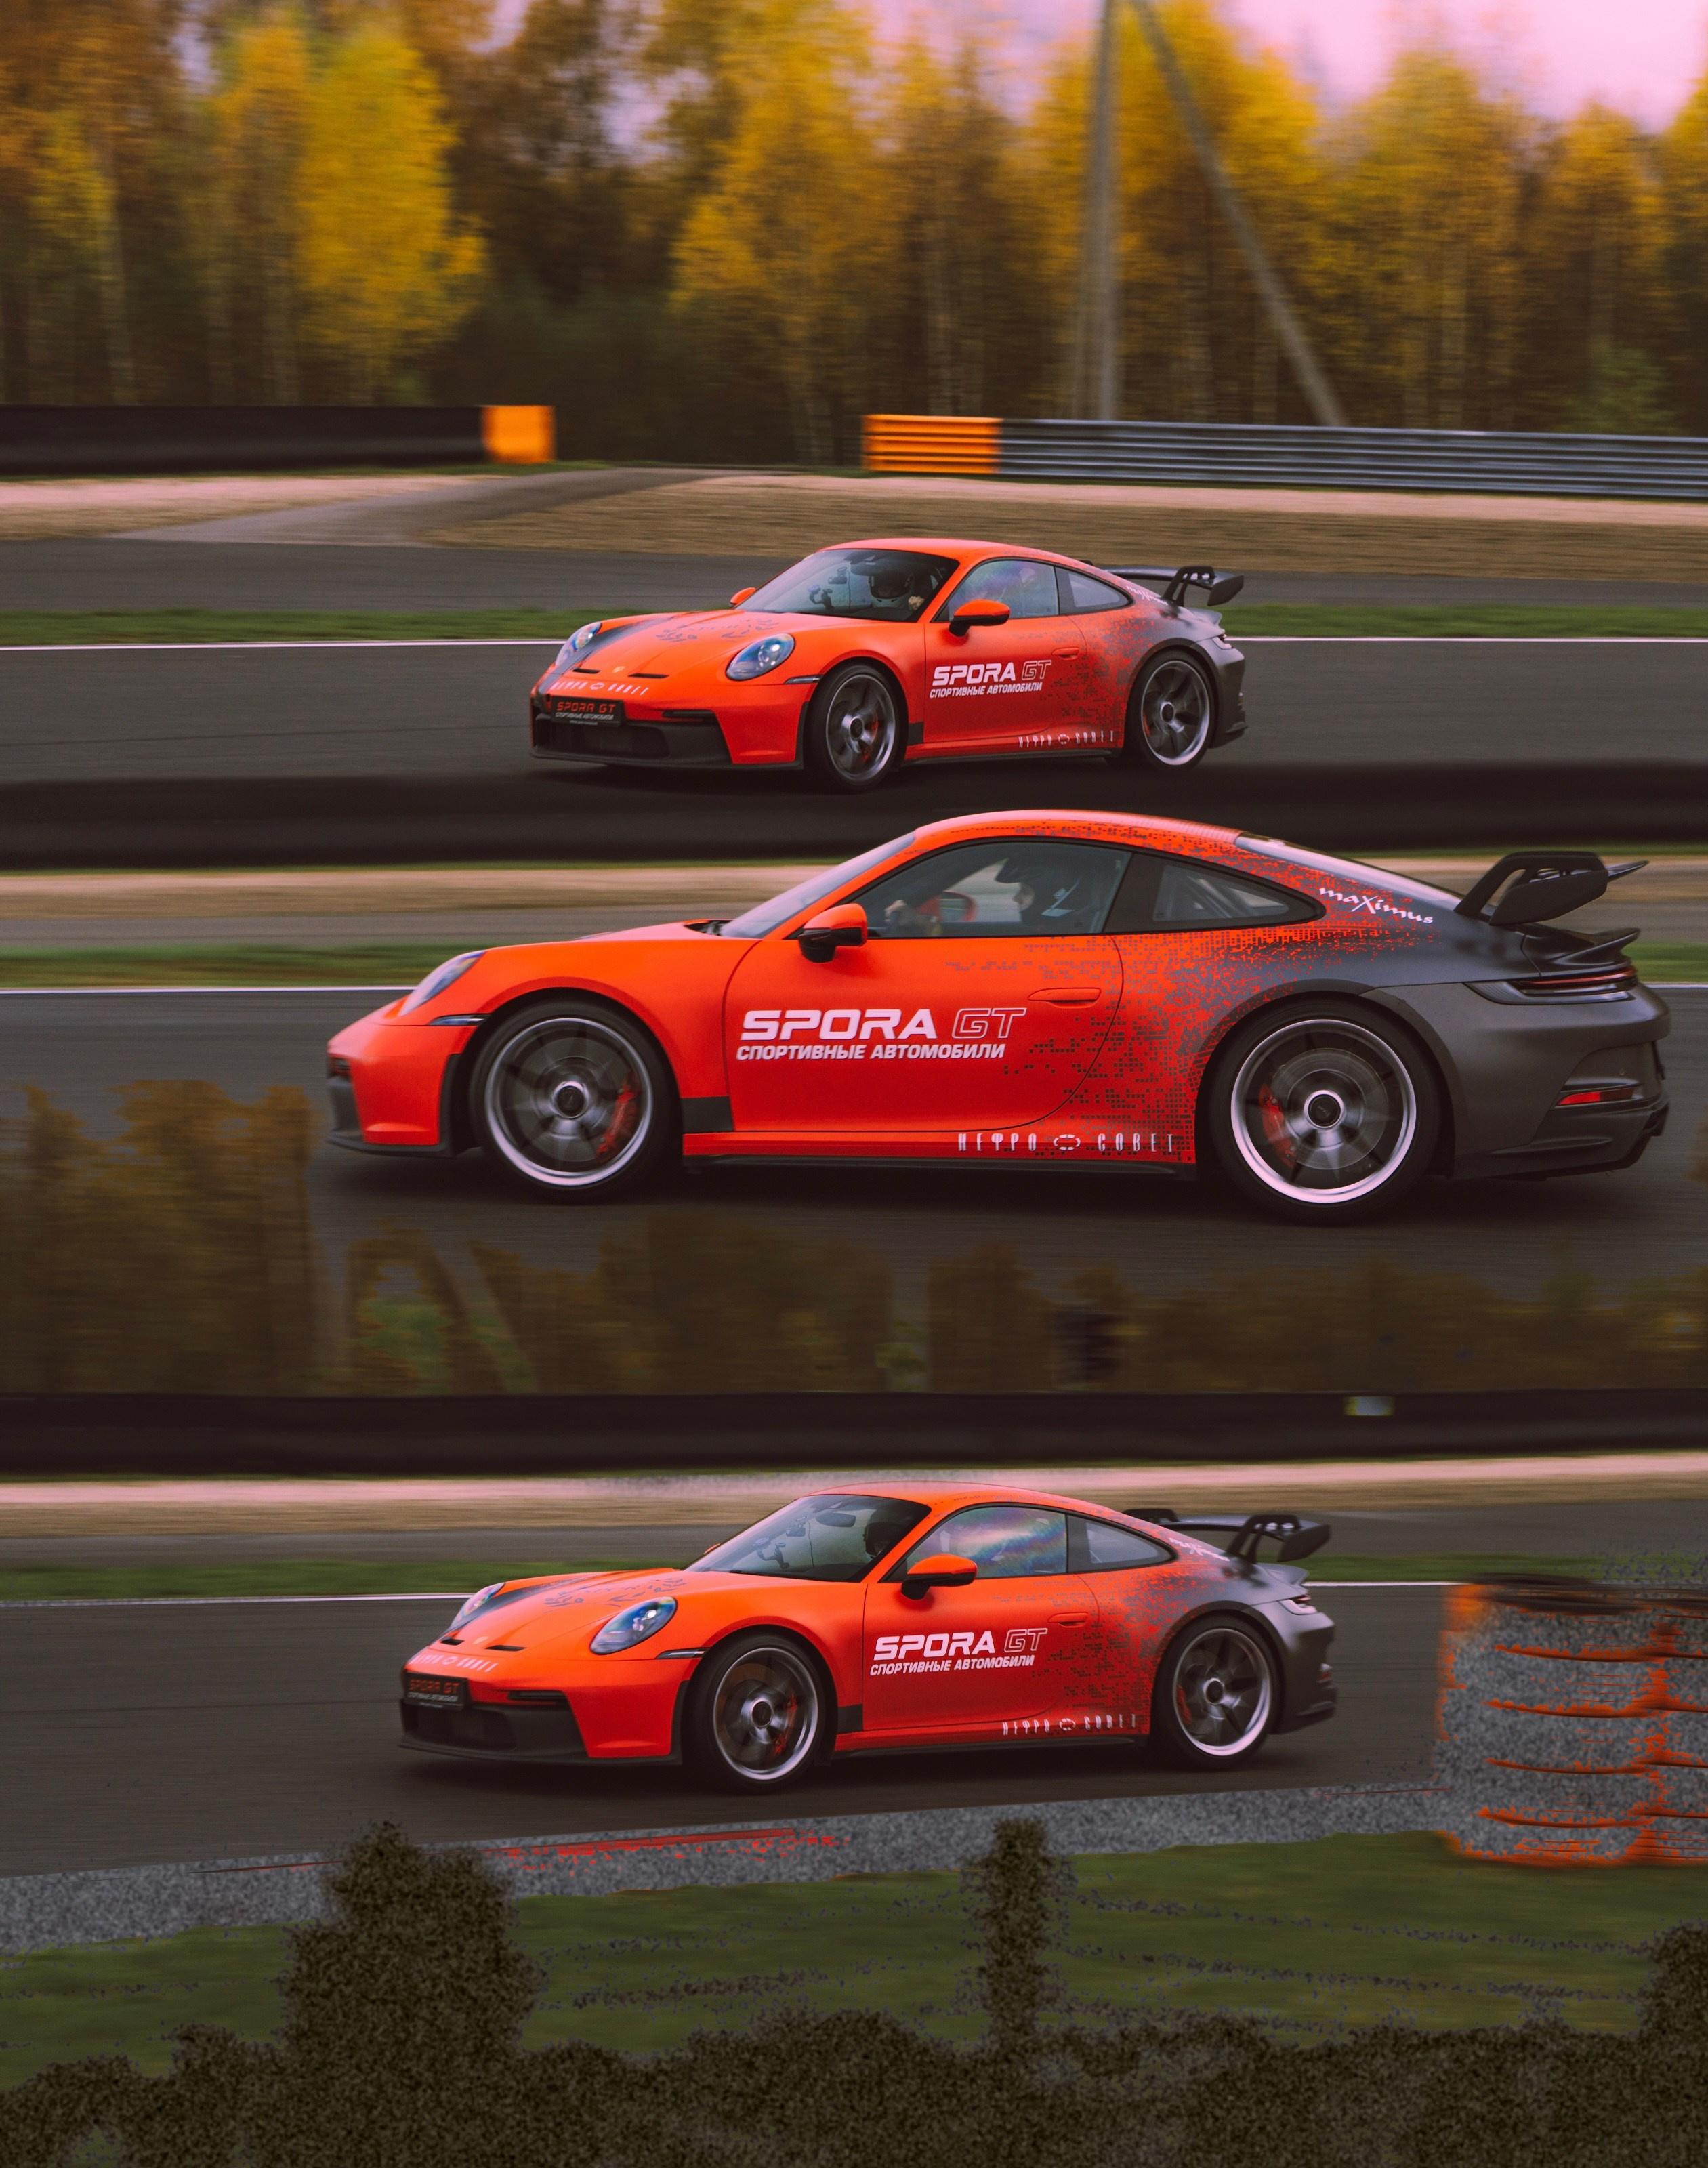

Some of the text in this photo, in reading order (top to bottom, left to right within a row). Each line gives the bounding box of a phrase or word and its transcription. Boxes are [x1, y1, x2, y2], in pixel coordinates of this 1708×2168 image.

[932, 660, 1052, 686] SPORA GT
[929, 682, 1043, 699] СПОРТИВНЫЕ АВТОМОБИЛИ
[557, 701, 616, 713] SPORA GT
[741, 1007, 1027, 1041] SPORA GT
[736, 1043, 1006, 1061] СПОРТИВНЫЕ АВТОМОБИЛИ
[874, 1628, 1048, 1661] SPORA GT
[870, 1655, 1035, 1676] СПОРТИВНЫЕ АВТОМОБИЛИ
